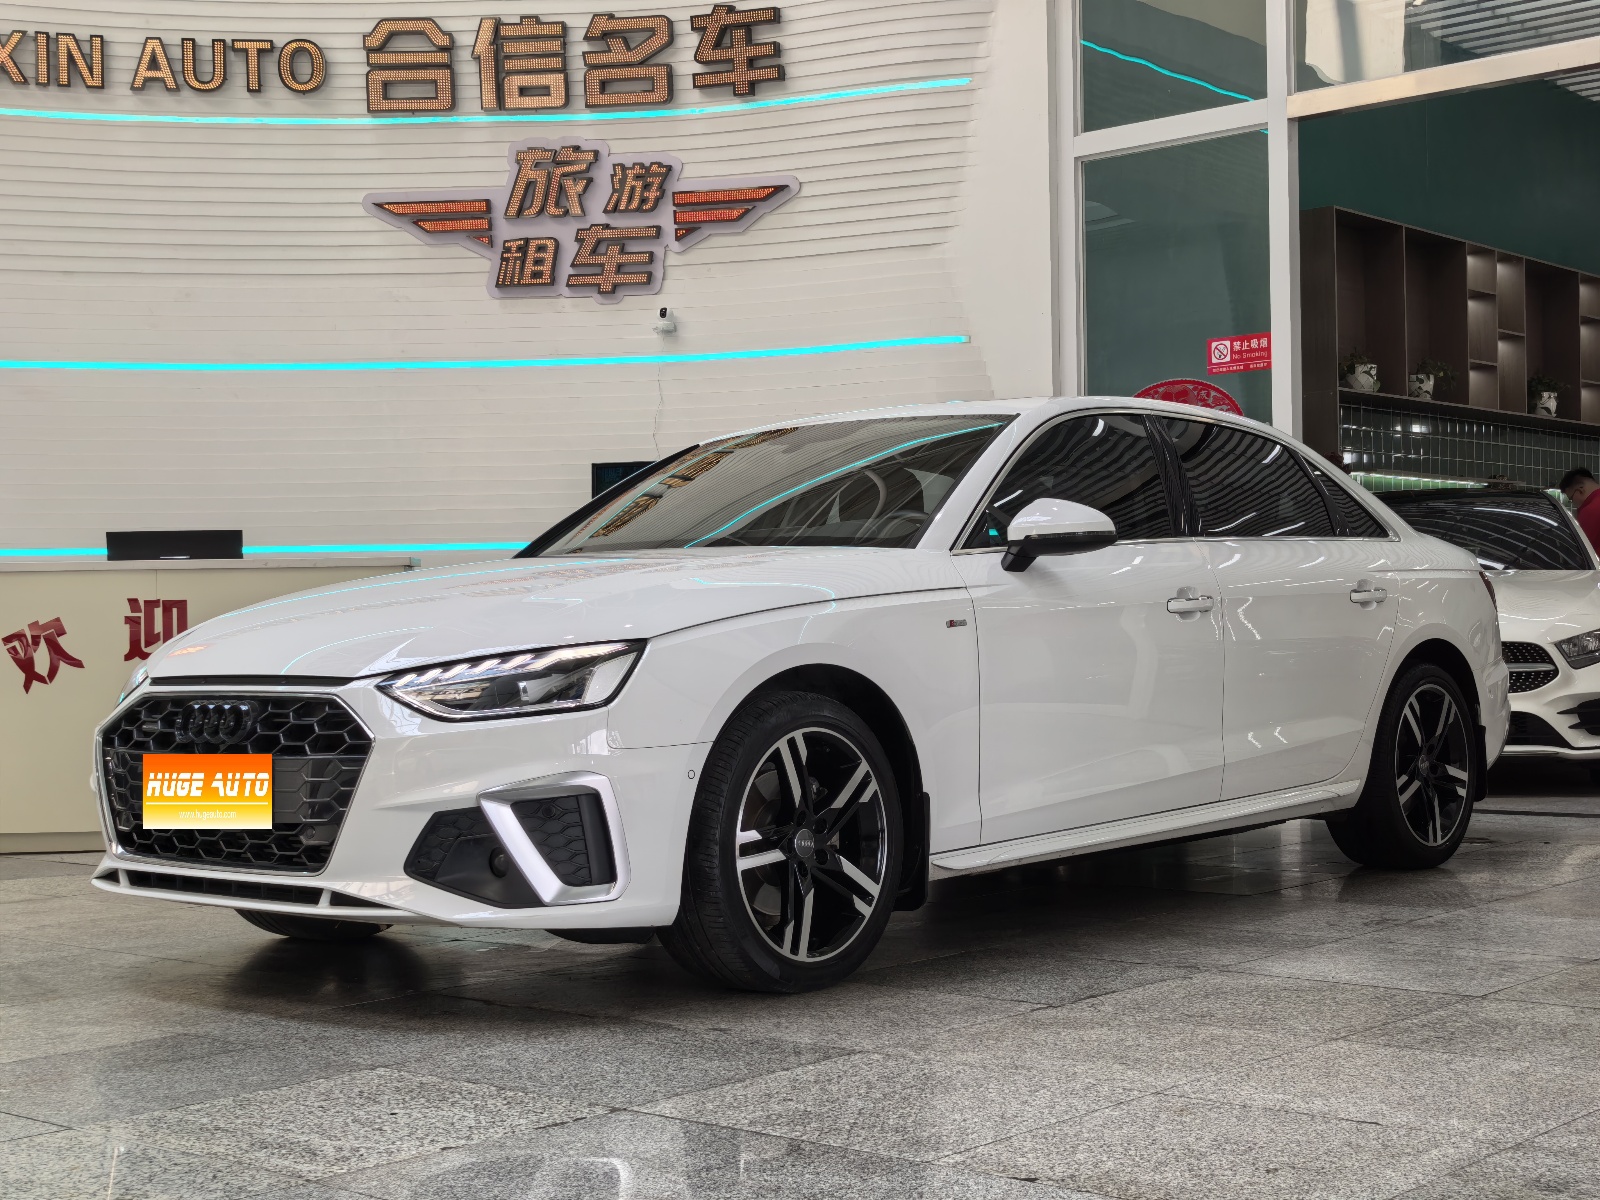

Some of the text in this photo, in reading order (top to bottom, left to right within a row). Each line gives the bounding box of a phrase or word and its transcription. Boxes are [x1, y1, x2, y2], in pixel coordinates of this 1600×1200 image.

[130, 37, 326, 94] AUTO
[363, 5, 786, 113] 合信名车
[503, 145, 673, 219] 旅游
[495, 223, 661, 294] 租车
[1233, 338, 1268, 351] 禁止吸烟
[1243, 350, 1268, 359] Smoking
